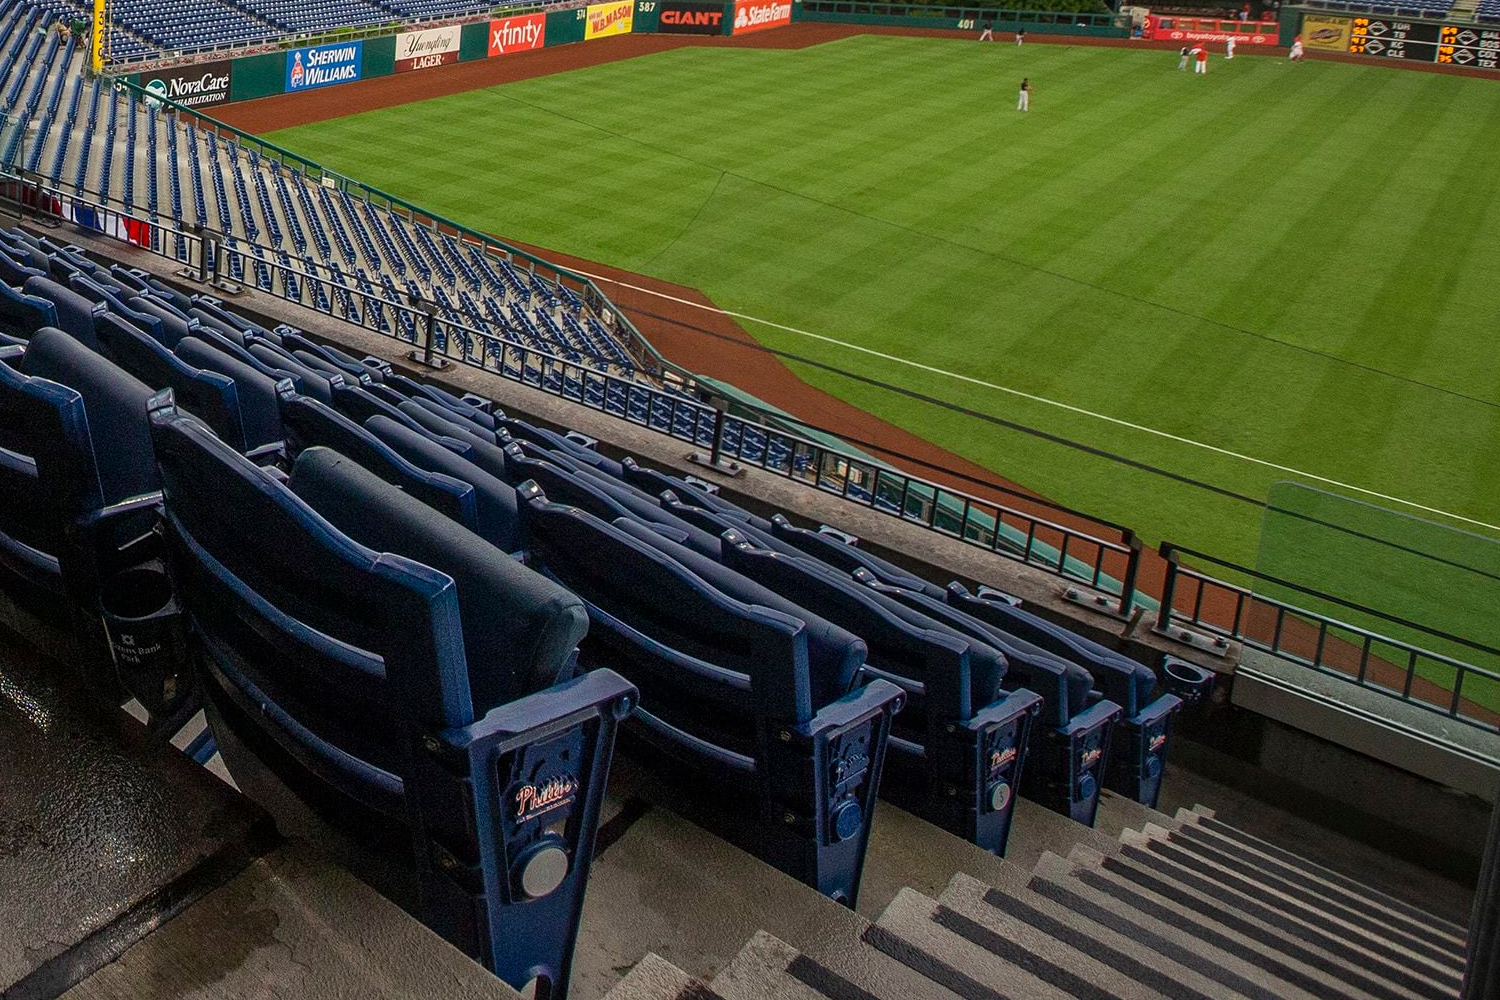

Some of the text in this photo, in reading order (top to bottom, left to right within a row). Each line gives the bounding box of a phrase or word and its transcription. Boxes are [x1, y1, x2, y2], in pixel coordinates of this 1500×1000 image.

[639, 1, 656, 13] 387
[660, 10, 722, 26] GIANT
[957, 19, 975, 30] 401
[492, 19, 542, 53] xfinity
[404, 31, 454, 58] Yuengling
[305, 47, 356, 67] SHERWIN
[1387, 49, 1405, 58] CLE
[413, 54, 442, 70] LAGER
[1477, 59, 1497, 68] TEX
[169, 75, 229, 98] NovaCare
